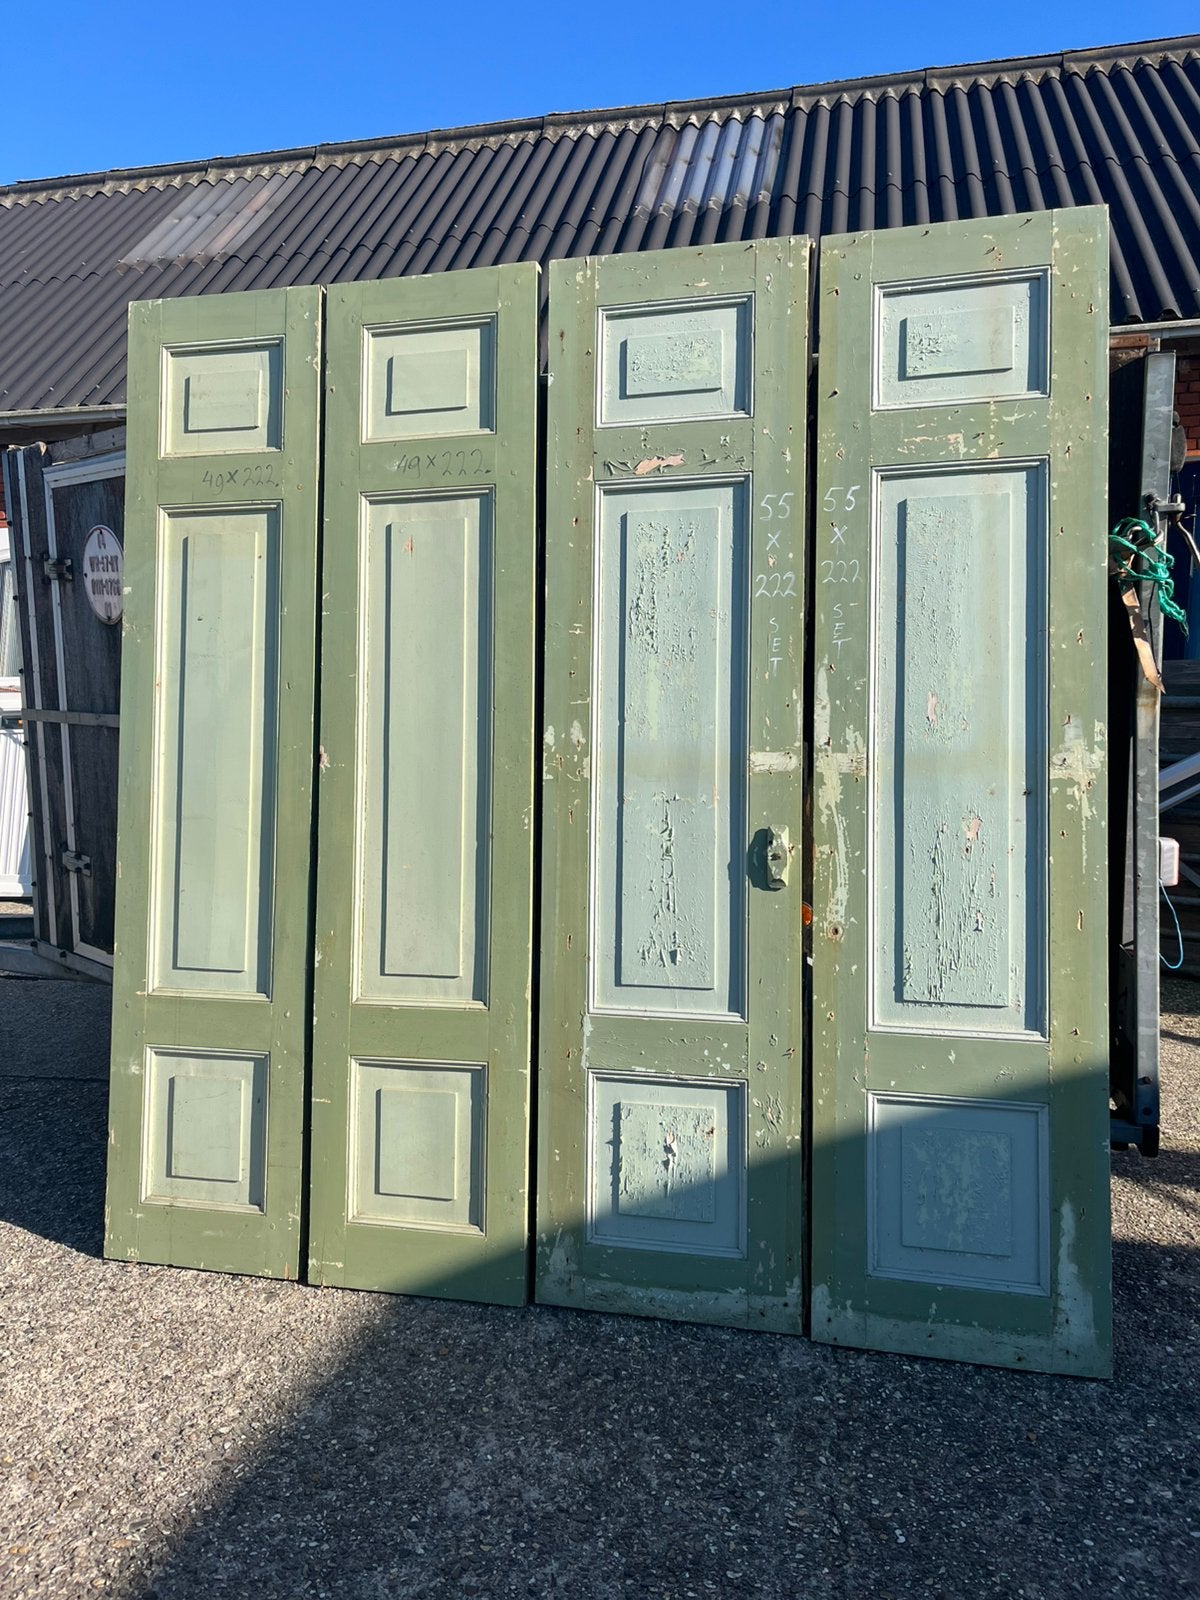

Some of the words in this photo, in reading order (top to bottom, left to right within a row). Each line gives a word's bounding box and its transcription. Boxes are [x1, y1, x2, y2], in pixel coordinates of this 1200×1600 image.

[759, 492, 795, 520] 55
[823, 485, 861, 512] 55
[755, 570, 797, 598] 222
[820, 559, 863, 584] 222
